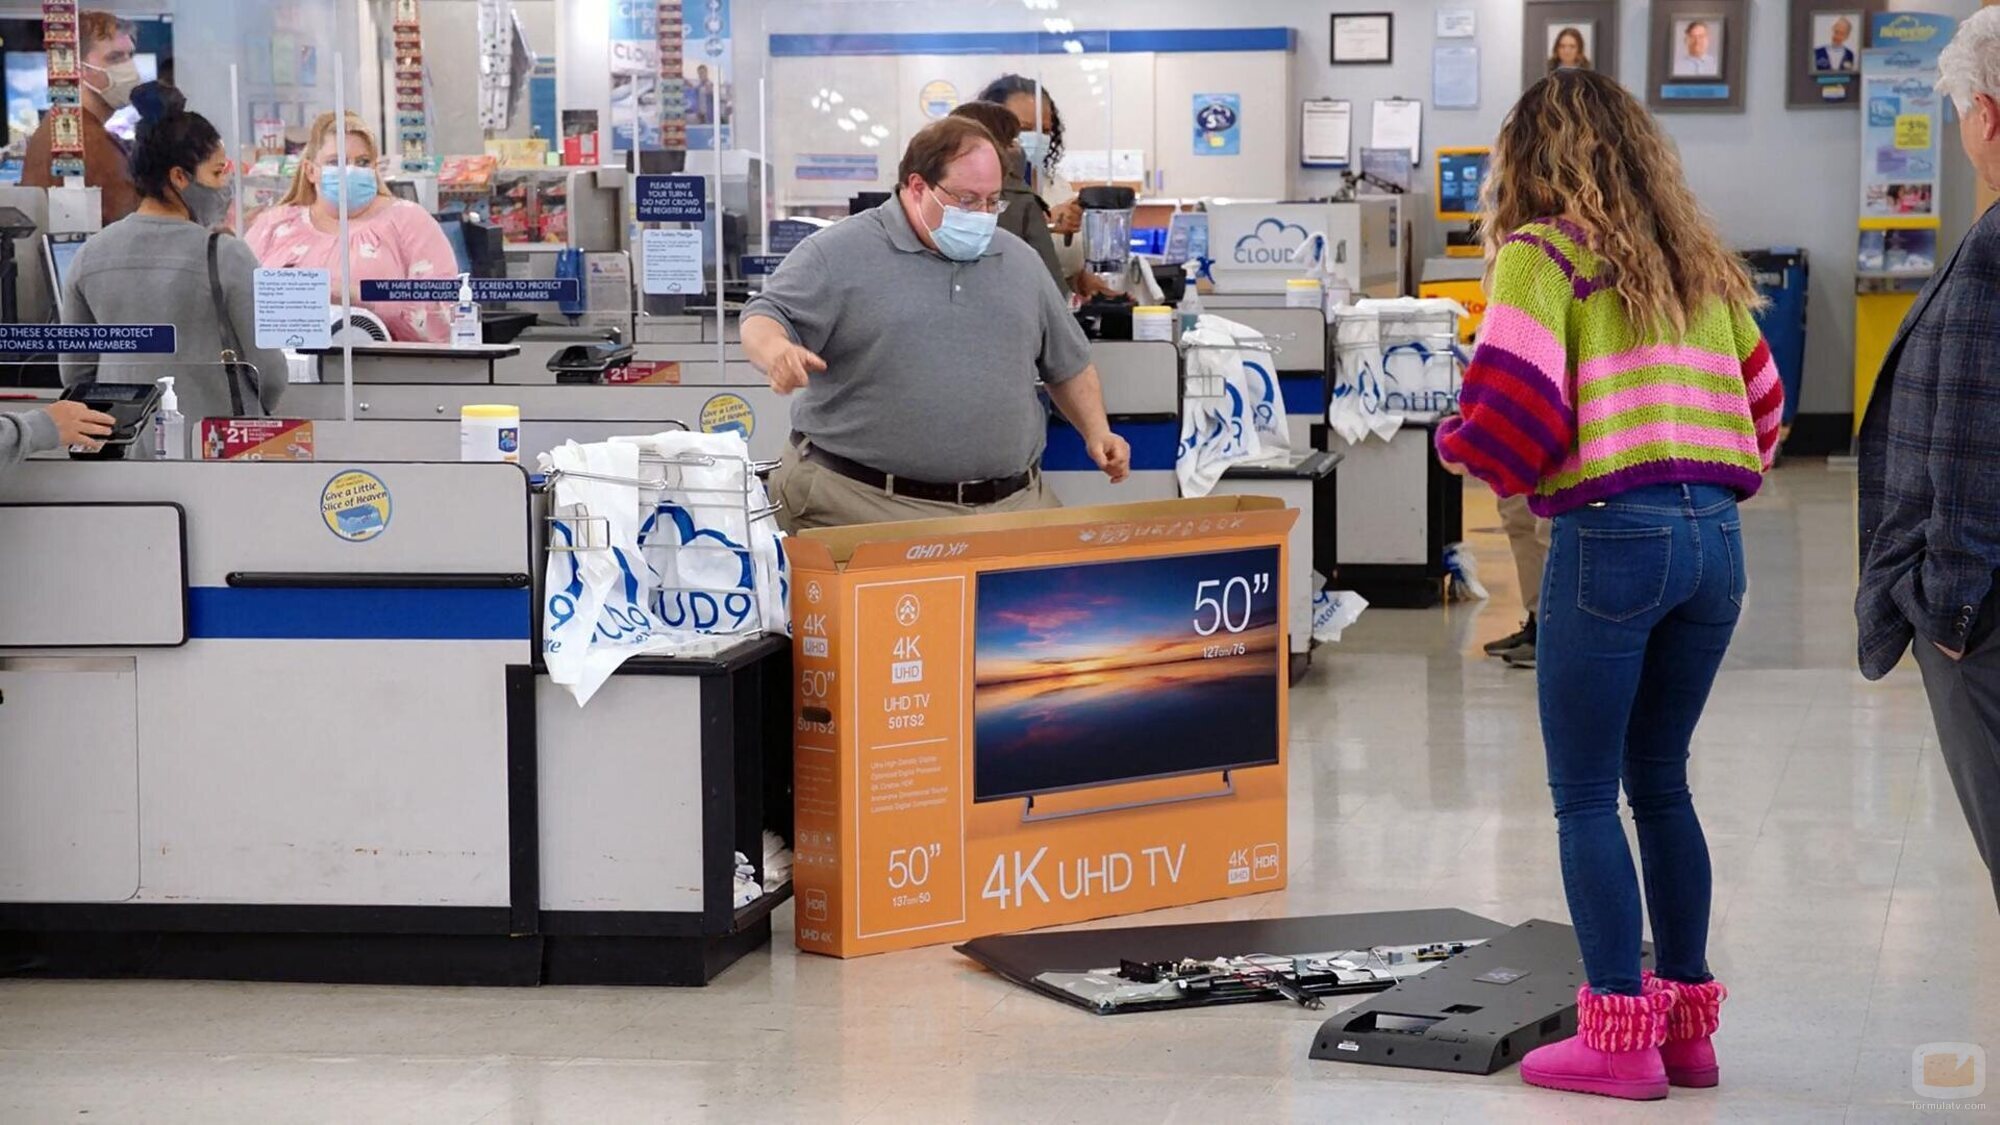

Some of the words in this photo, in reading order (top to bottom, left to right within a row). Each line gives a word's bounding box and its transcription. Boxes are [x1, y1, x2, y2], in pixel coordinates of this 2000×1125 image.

[650, 182, 672, 190] PLEASE
[674, 182, 691, 190] WAIT
[648, 190, 666, 198] YOUR
[668, 190, 686, 198] TURN
[688, 190, 694, 198] &
[642, 198, 654, 206] DO
[655, 198, 670, 206] NOT
[672, 198, 700, 206] CROWD
[376, 282, 390, 290] WE
[391, 282, 412, 290] HAVE
[414, 282, 452, 290] INSTALLED
[479, 282, 514, 290] SCREENS
[516, 282, 526, 290] TO
[528, 282, 562, 290] PROTECT
[389, 290, 410, 299] BOTH
[412, 290, 430, 299] OUR
[481, 290, 489, 299] &
[489, 290, 511, 299] TEAM
[512, 290, 549, 299] MEMBERS
[12, 328, 40, 338] THESE
[44, 328, 90, 338] SCREENS
[93, 328, 108, 338] TO
[110, 328, 154, 338] PROTECT
[47, 340, 56, 350] &
[58, 340, 86, 350] TEAM
[88, 340, 137, 350] MEMBERS
[610, 368, 629, 380] 21
[227, 428, 248, 444] 21
[325, 491, 344, 501] Give
[354, 482, 377, 494] Little
[323, 501, 343, 512] Slice
[344, 498, 354, 507] of
[356, 491, 388, 504] Heaven
[906, 544, 944, 560] UHD
[803, 614, 827, 636] 4K
[805, 639, 826, 654] UHD
[892, 635, 922, 660] 4K
[894, 665, 920, 680] UHD
[884, 696, 912, 713] UHD
[914, 694, 930, 708] TV
[888, 713, 925, 730] 50TS2
[1228, 848, 1249, 866] 4K
[1254, 854, 1279, 869] HDR
[981, 846, 1050, 910] 4K
[1059, 852, 1133, 900] UHD
[1142, 843, 1186, 886] TV
[806, 897, 827, 912] HDR
[800, 928, 819, 941] UHD
[820, 930, 833, 943] 4K
